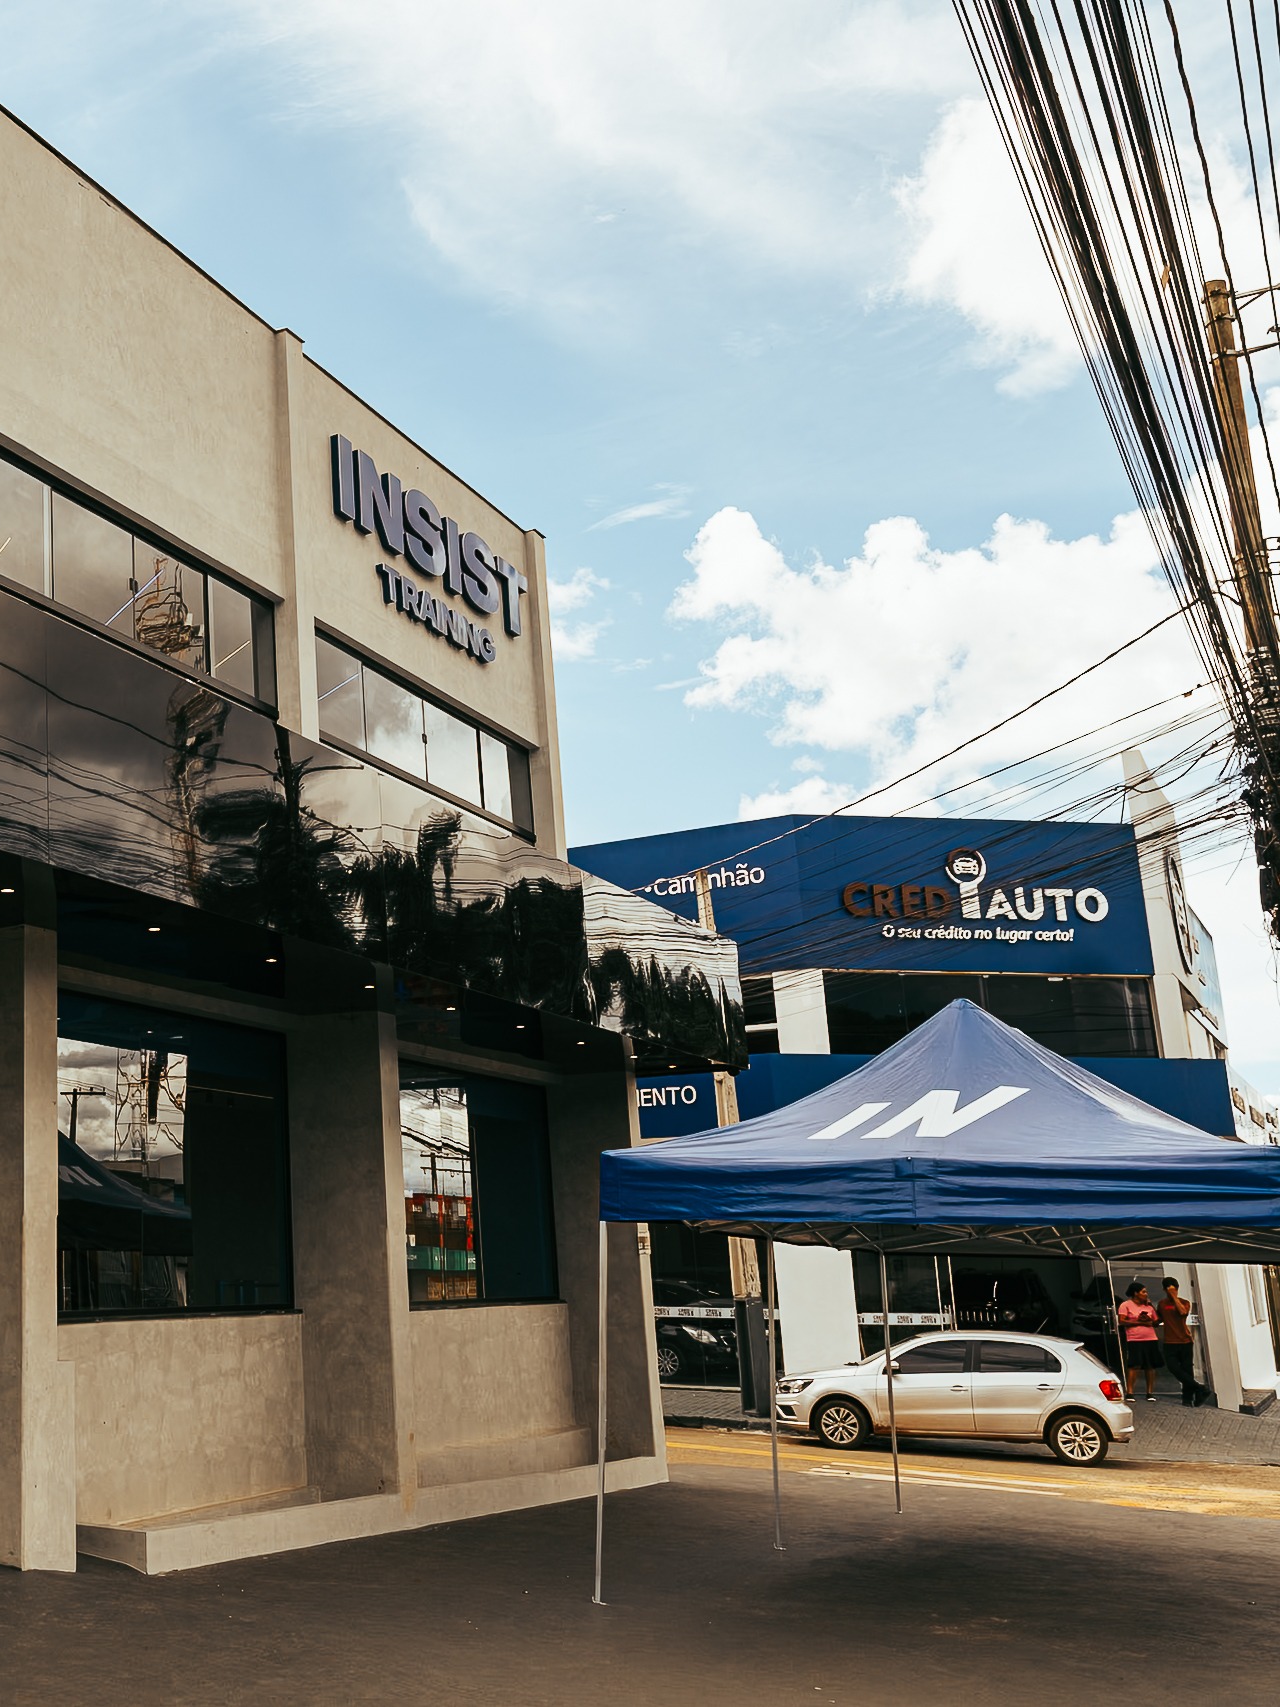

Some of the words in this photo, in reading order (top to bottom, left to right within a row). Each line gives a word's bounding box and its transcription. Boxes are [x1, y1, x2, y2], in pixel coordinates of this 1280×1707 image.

[329, 433, 527, 637] INSIST
[375, 562, 496, 664] TRAINING
[654, 863, 765, 896] Camnhão
[882, 924, 895, 938] O
[897, 927, 922, 939] seu
[924, 925, 971, 940] crédito
[973, 929, 993, 940] no
[995, 926, 1033, 944] lugar
[1034, 928, 1075, 942] certo!
[808, 1085, 1031, 1140] IN
